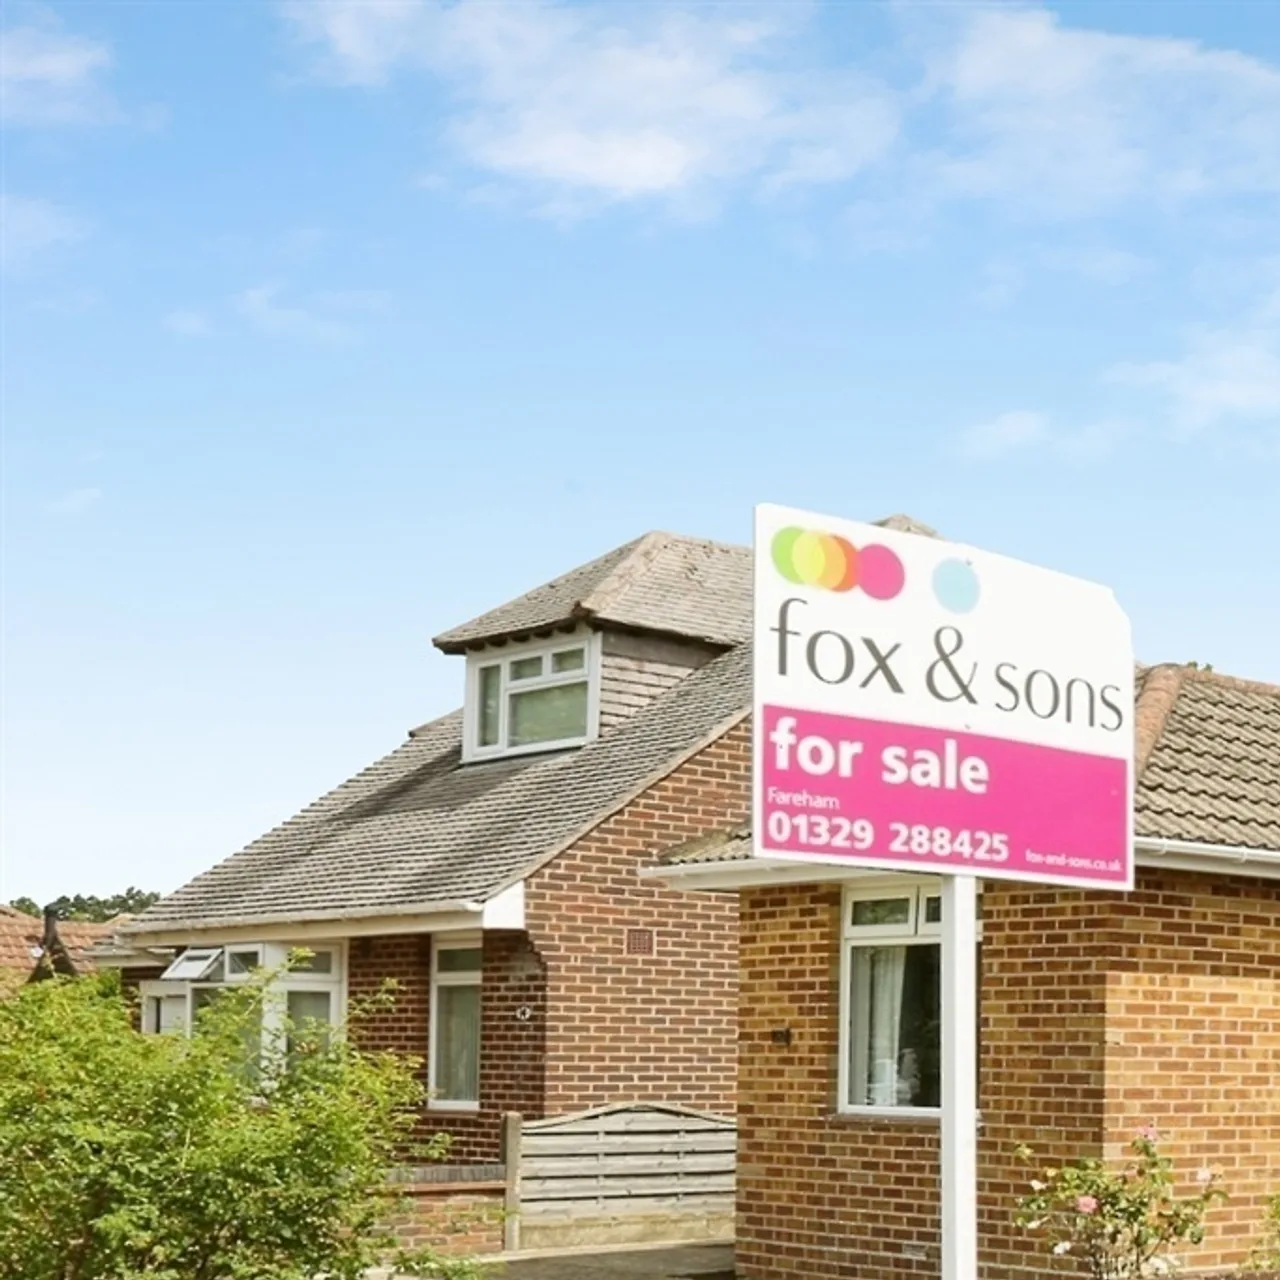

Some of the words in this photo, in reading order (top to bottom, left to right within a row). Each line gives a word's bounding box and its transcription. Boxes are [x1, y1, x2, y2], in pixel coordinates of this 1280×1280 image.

[770, 598, 904, 694] fox
[925, 625, 978, 704] &
[994, 662, 1123, 732] sons
[769, 716, 864, 778] for
[881, 738, 990, 794] sale
[767, 787, 840, 810] Fareham
[768, 811, 874, 849] 01329
[889, 823, 1009, 862] 288425
